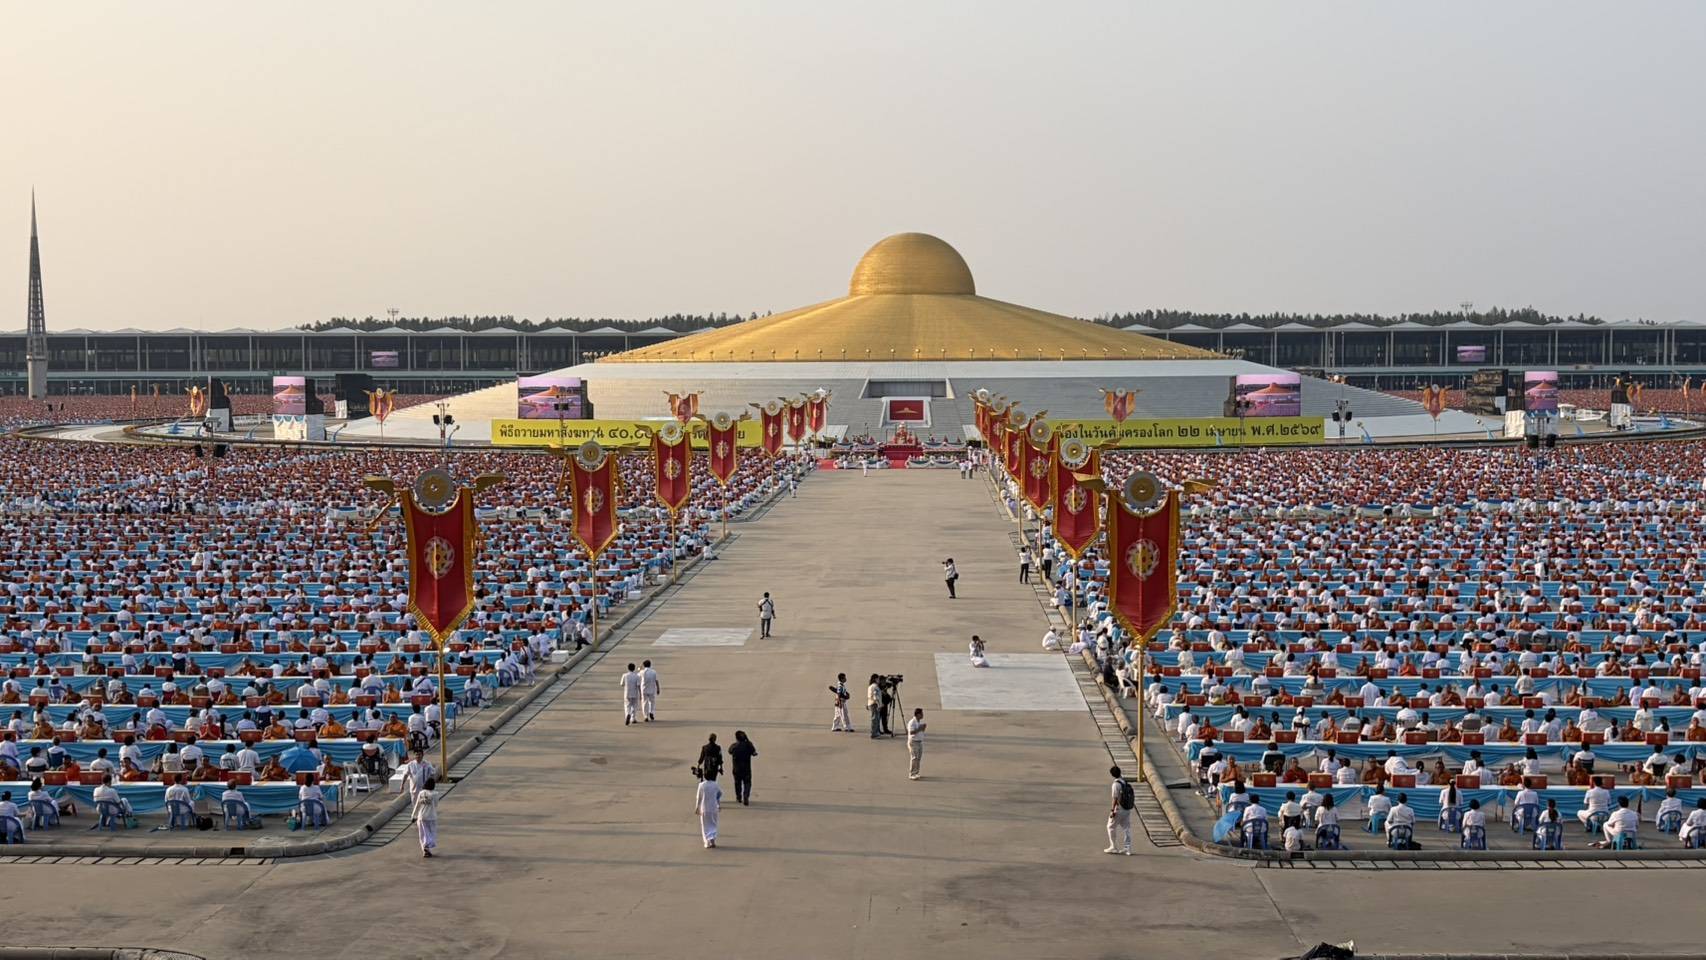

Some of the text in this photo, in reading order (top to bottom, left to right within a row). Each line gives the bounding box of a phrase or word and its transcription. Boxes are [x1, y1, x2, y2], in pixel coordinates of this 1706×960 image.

[1177, 425, 1200, 437] ๒๒
[1251, 423, 1322, 436] พ.ศ.๒๕๖๙
